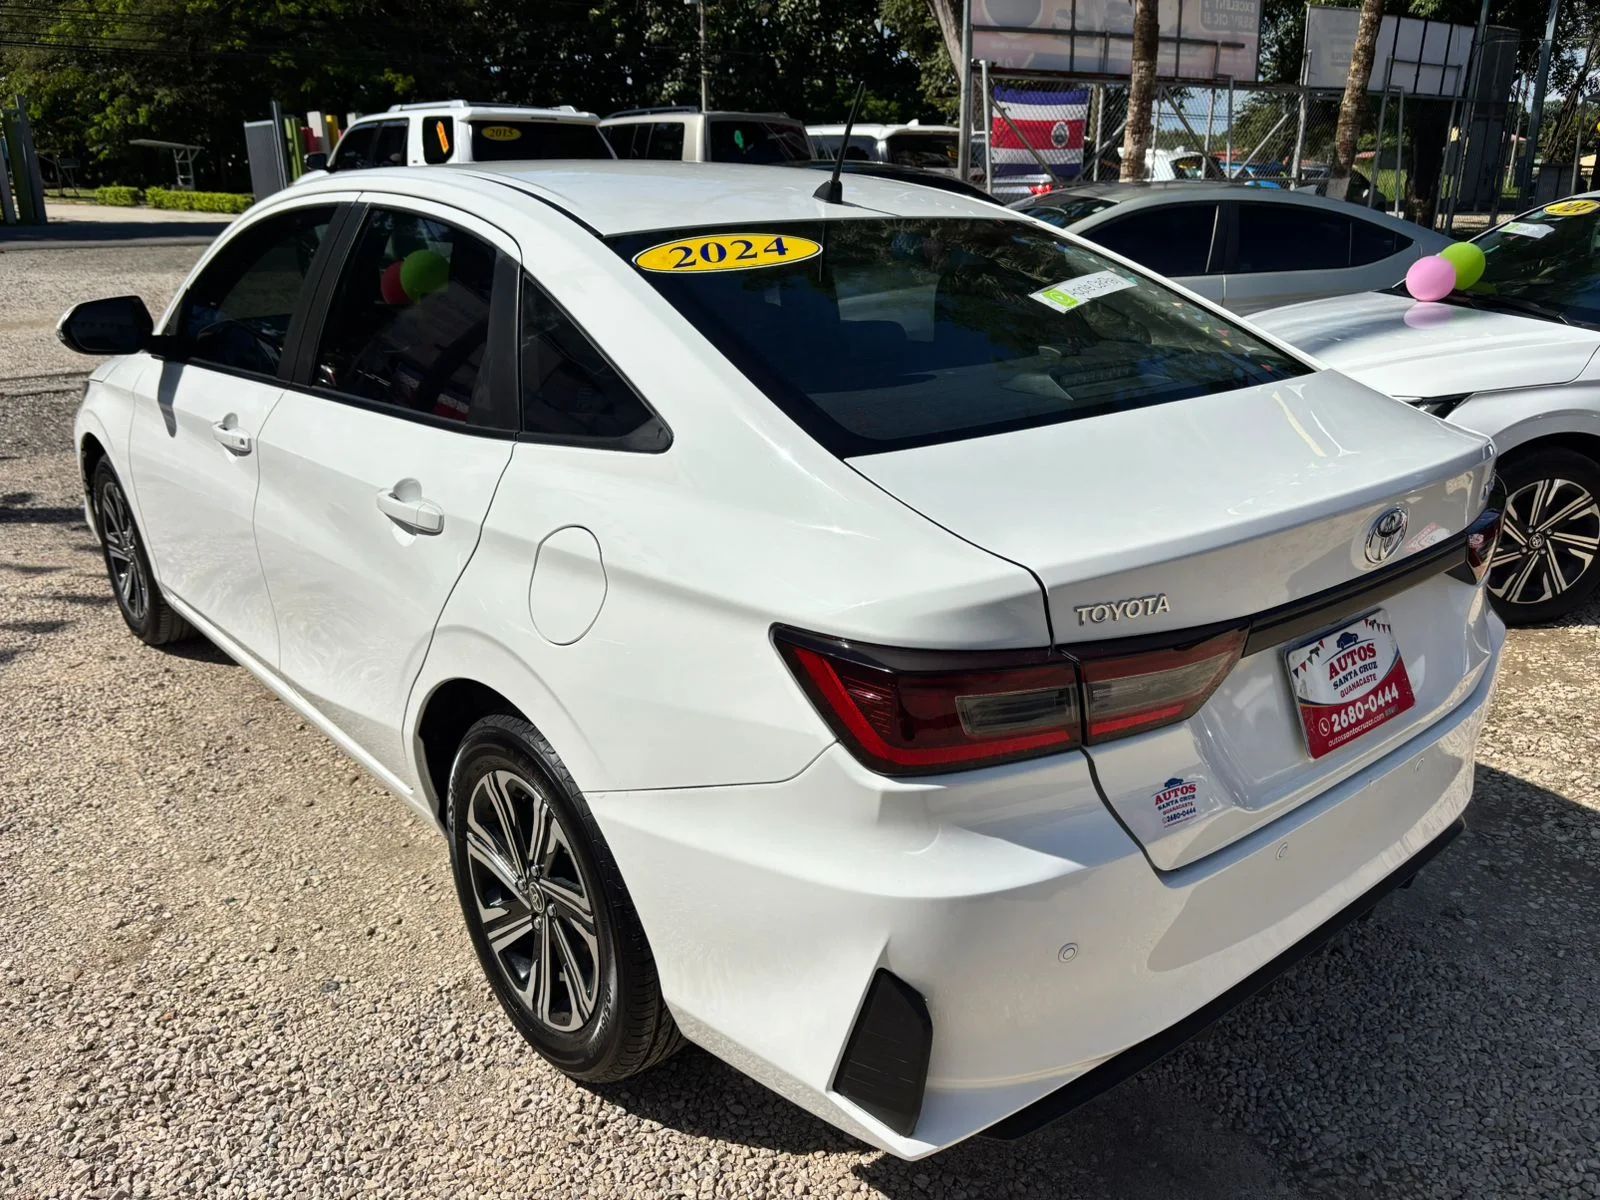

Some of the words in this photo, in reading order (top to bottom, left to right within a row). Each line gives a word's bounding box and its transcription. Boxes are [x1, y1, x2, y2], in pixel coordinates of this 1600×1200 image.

[669, 237, 789, 269] 2024
[1073, 593, 1171, 626] TOYOTA
[1328, 643, 1377, 681] AUTOS
[1333, 669, 1358, 690] SANTA
[1359, 661, 1378, 675] CRUZ
[1340, 673, 1378, 698] GUANACASTE
[1331, 682, 1399, 733] 2680-0444
[1155, 783, 1197, 806] AUTOS
[1157, 798, 1179, 810] SANTA
